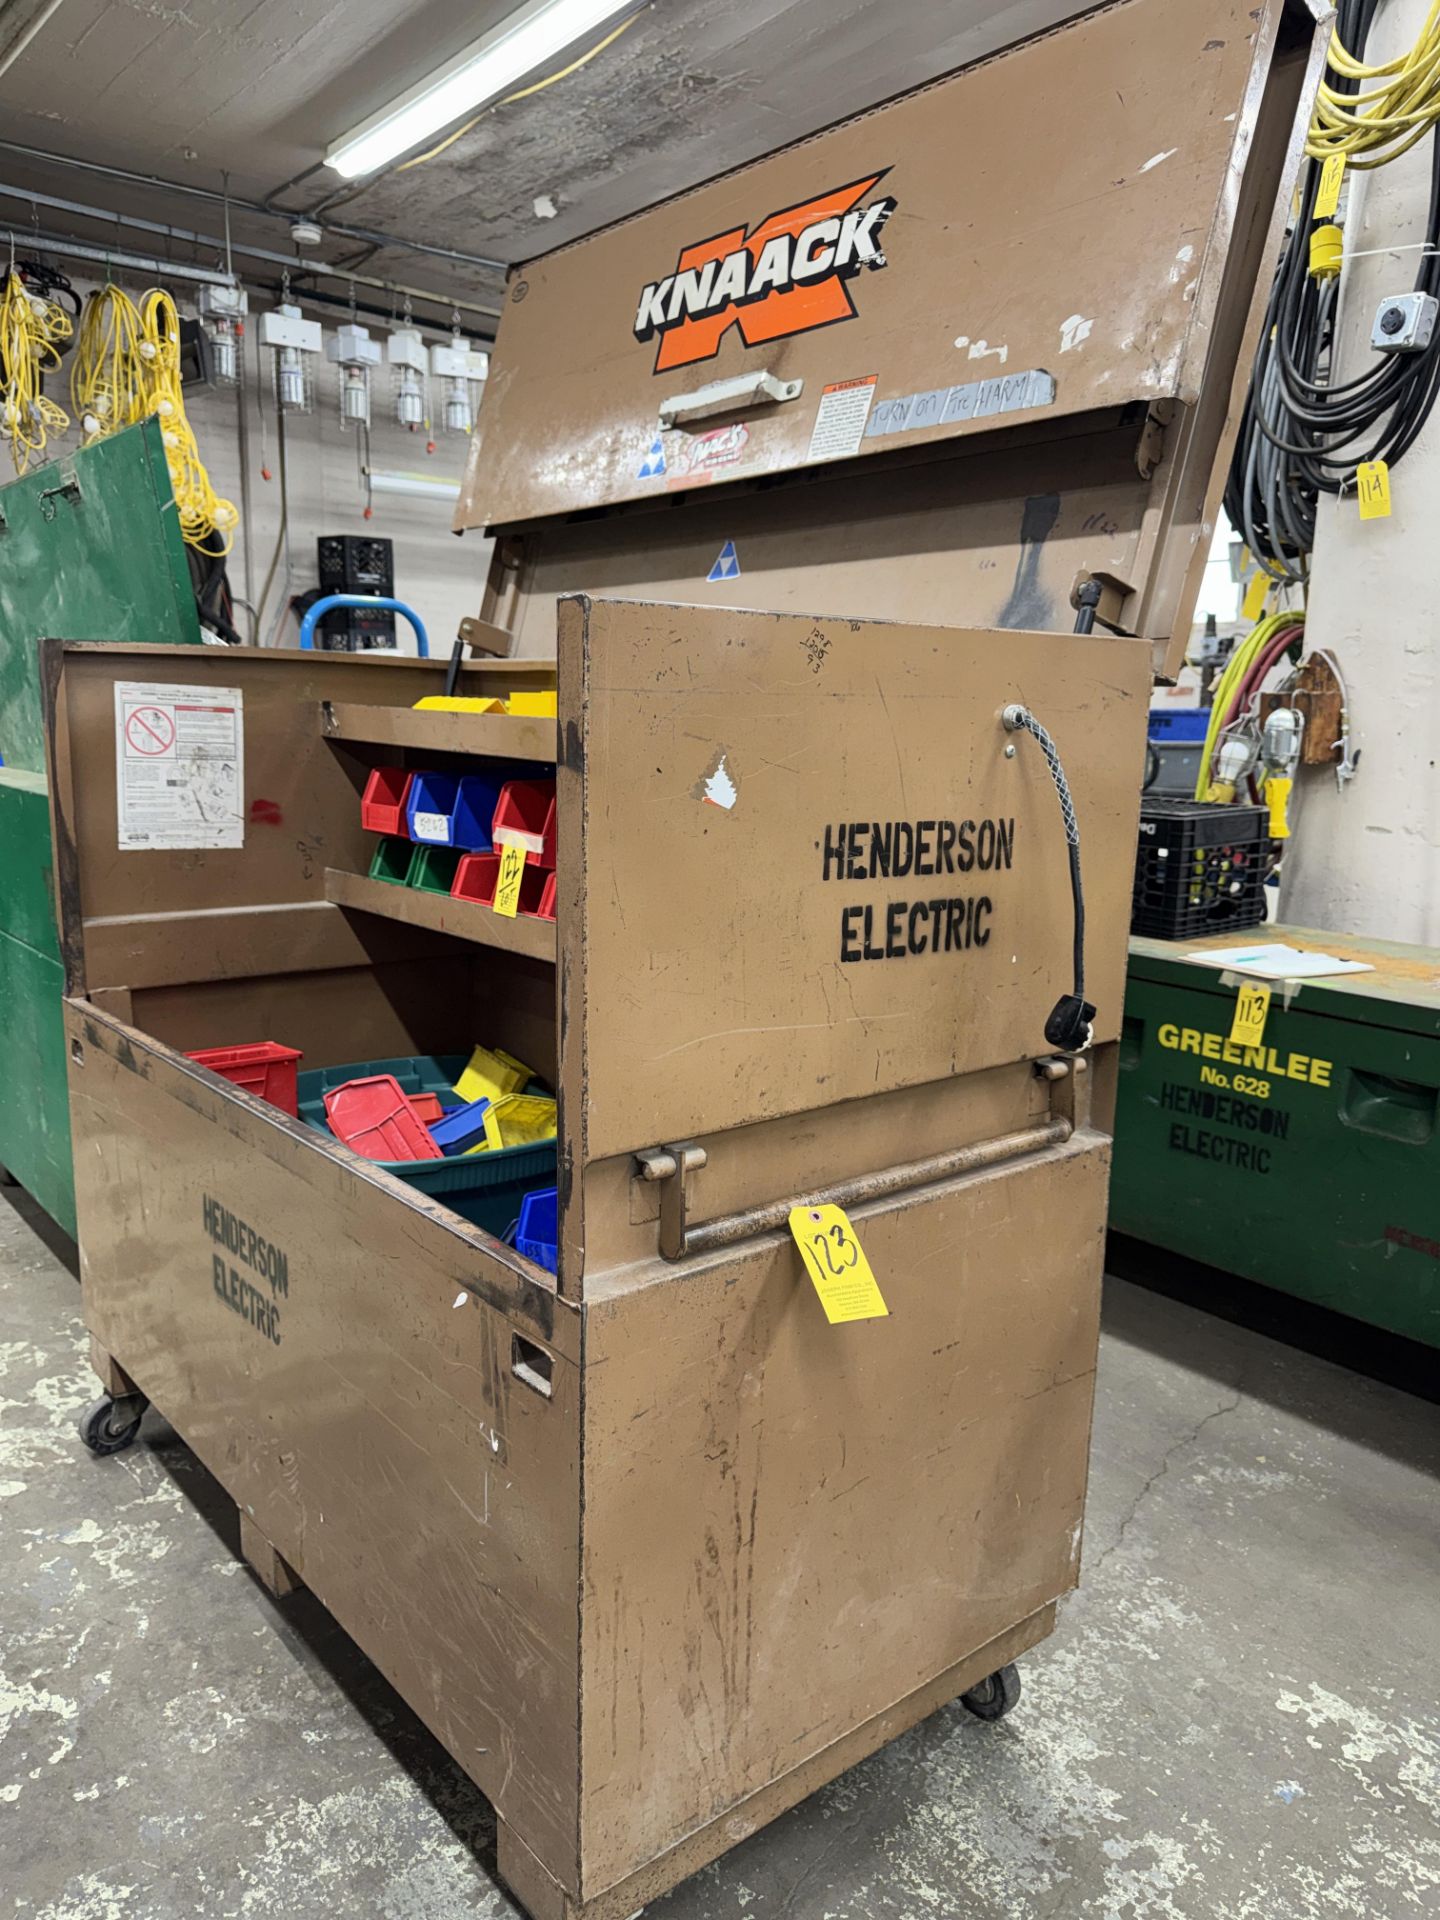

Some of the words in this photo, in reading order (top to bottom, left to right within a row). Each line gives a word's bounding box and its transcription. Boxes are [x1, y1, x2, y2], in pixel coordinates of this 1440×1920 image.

[633, 197, 898, 342] KNAACK
[1361, 474, 1383, 504] 114
[823, 818, 1014, 881] HENDERSON
[841, 896, 992, 962] ELECTRIC
[1239, 995, 1265, 1025] 113
[1158, 1023, 1333, 1088] GREENLEE
[1200, 1065, 1231, 1089] No.
[1233, 1075, 1271, 1099] 628
[1161, 1083, 1290, 1141] HENDERSON
[1169, 1123, 1271, 1175] ELECTRIC
[203, 1192, 289, 1300] HENDERSON
[803, 1225, 857, 1280] 123
[213, 1253, 281, 1346] ELECTRIC
